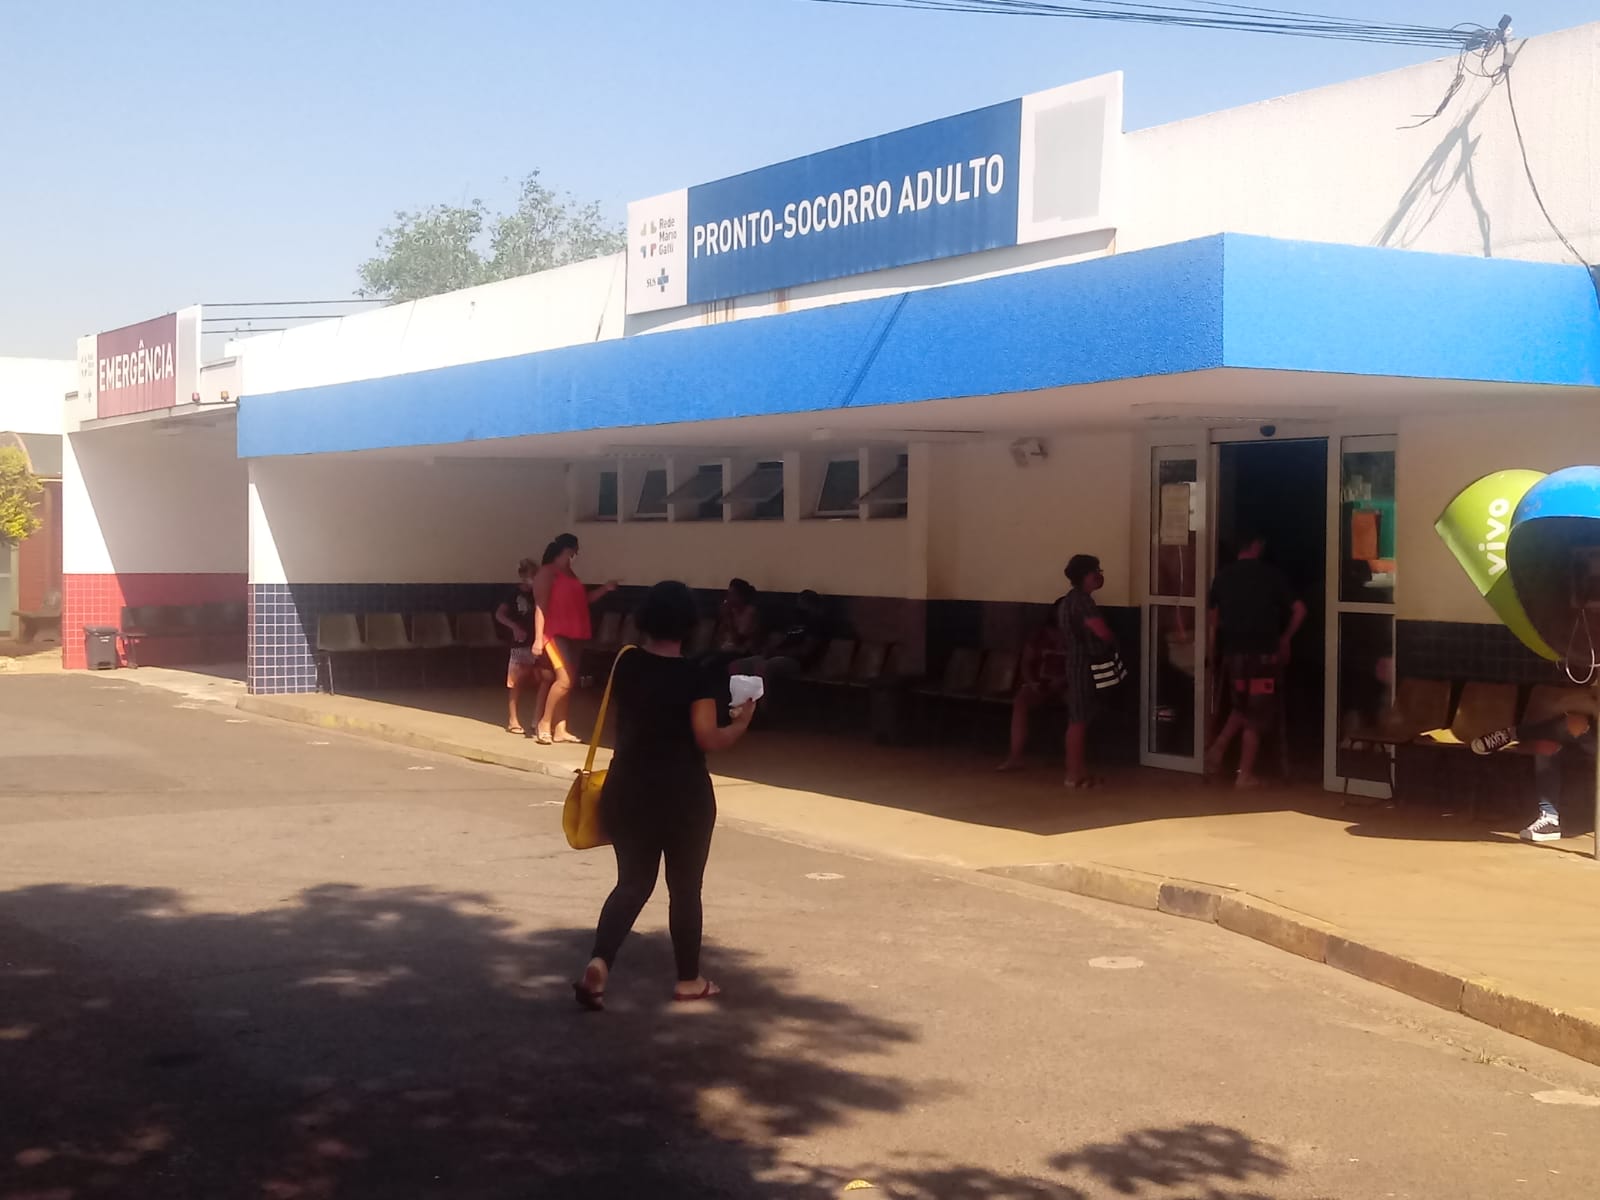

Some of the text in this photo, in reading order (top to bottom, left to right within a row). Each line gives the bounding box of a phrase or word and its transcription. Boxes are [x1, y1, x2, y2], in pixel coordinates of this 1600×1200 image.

[659, 217, 675, 229] Rede
[693, 153, 1005, 258] PRONTO-SOCORRO ADULTO
[99, 339, 174, 392] EMERGÊNCIA
[1478, 498, 1509, 575] vivo
